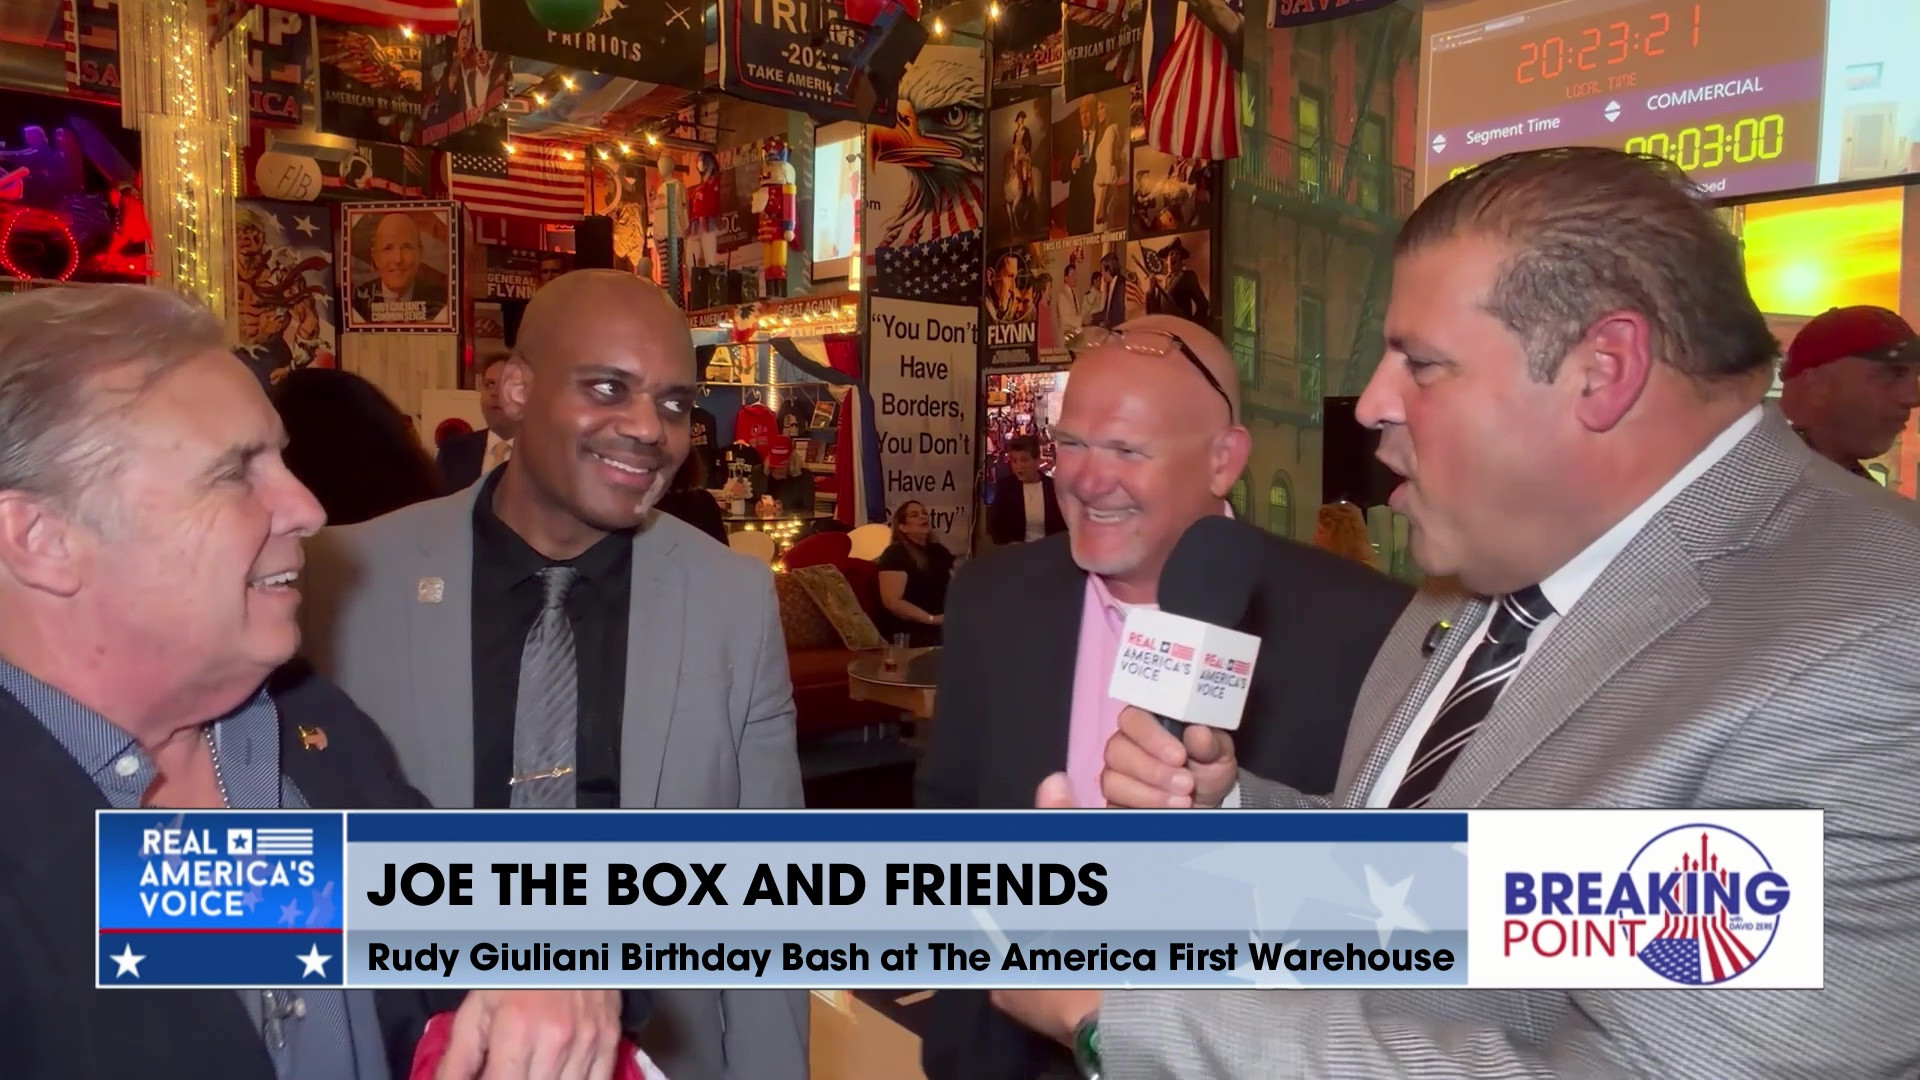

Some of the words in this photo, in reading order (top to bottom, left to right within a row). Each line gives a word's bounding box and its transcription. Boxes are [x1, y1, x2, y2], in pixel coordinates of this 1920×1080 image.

[548, 29, 642, 62] PATRIOTS
[1517, 4, 1700, 84] 20:23:21
[747, 63, 784, 83] TAKE
[1567, 77, 1602, 99] LOCAL
[1608, 72, 1637, 91] TIME
[1647, 76, 1763, 111] COMMERCIAL
[325, 90, 375, 108] AMERICAN
[1466, 121, 1523, 146] Segment
[1527, 115, 1560, 134] Time
[487, 272, 537, 286] GENERAL
[487, 283, 537, 299] FLYNN
[777, 303, 804, 317] GREAT
[805, 297, 838, 315] AGAIN!
[988, 322, 1035, 345] FLYNN
[900, 355, 948, 380] Have
[882, 393, 964, 422] Borders,
[877, 431, 912, 456] You
[919, 432, 970, 455] Don’t
[888, 470, 936, 492] Have
[941, 470, 955, 492] A
[1128, 632, 1156, 651] REAL
[1121, 661, 1161, 682] VOICE
[1123, 648, 1192, 675] AMERICA'S
[1205, 653, 1224, 669] REAL
[1200, 670, 1247, 689] AMERICA'S
[1197, 683, 1225, 699] VOICE
